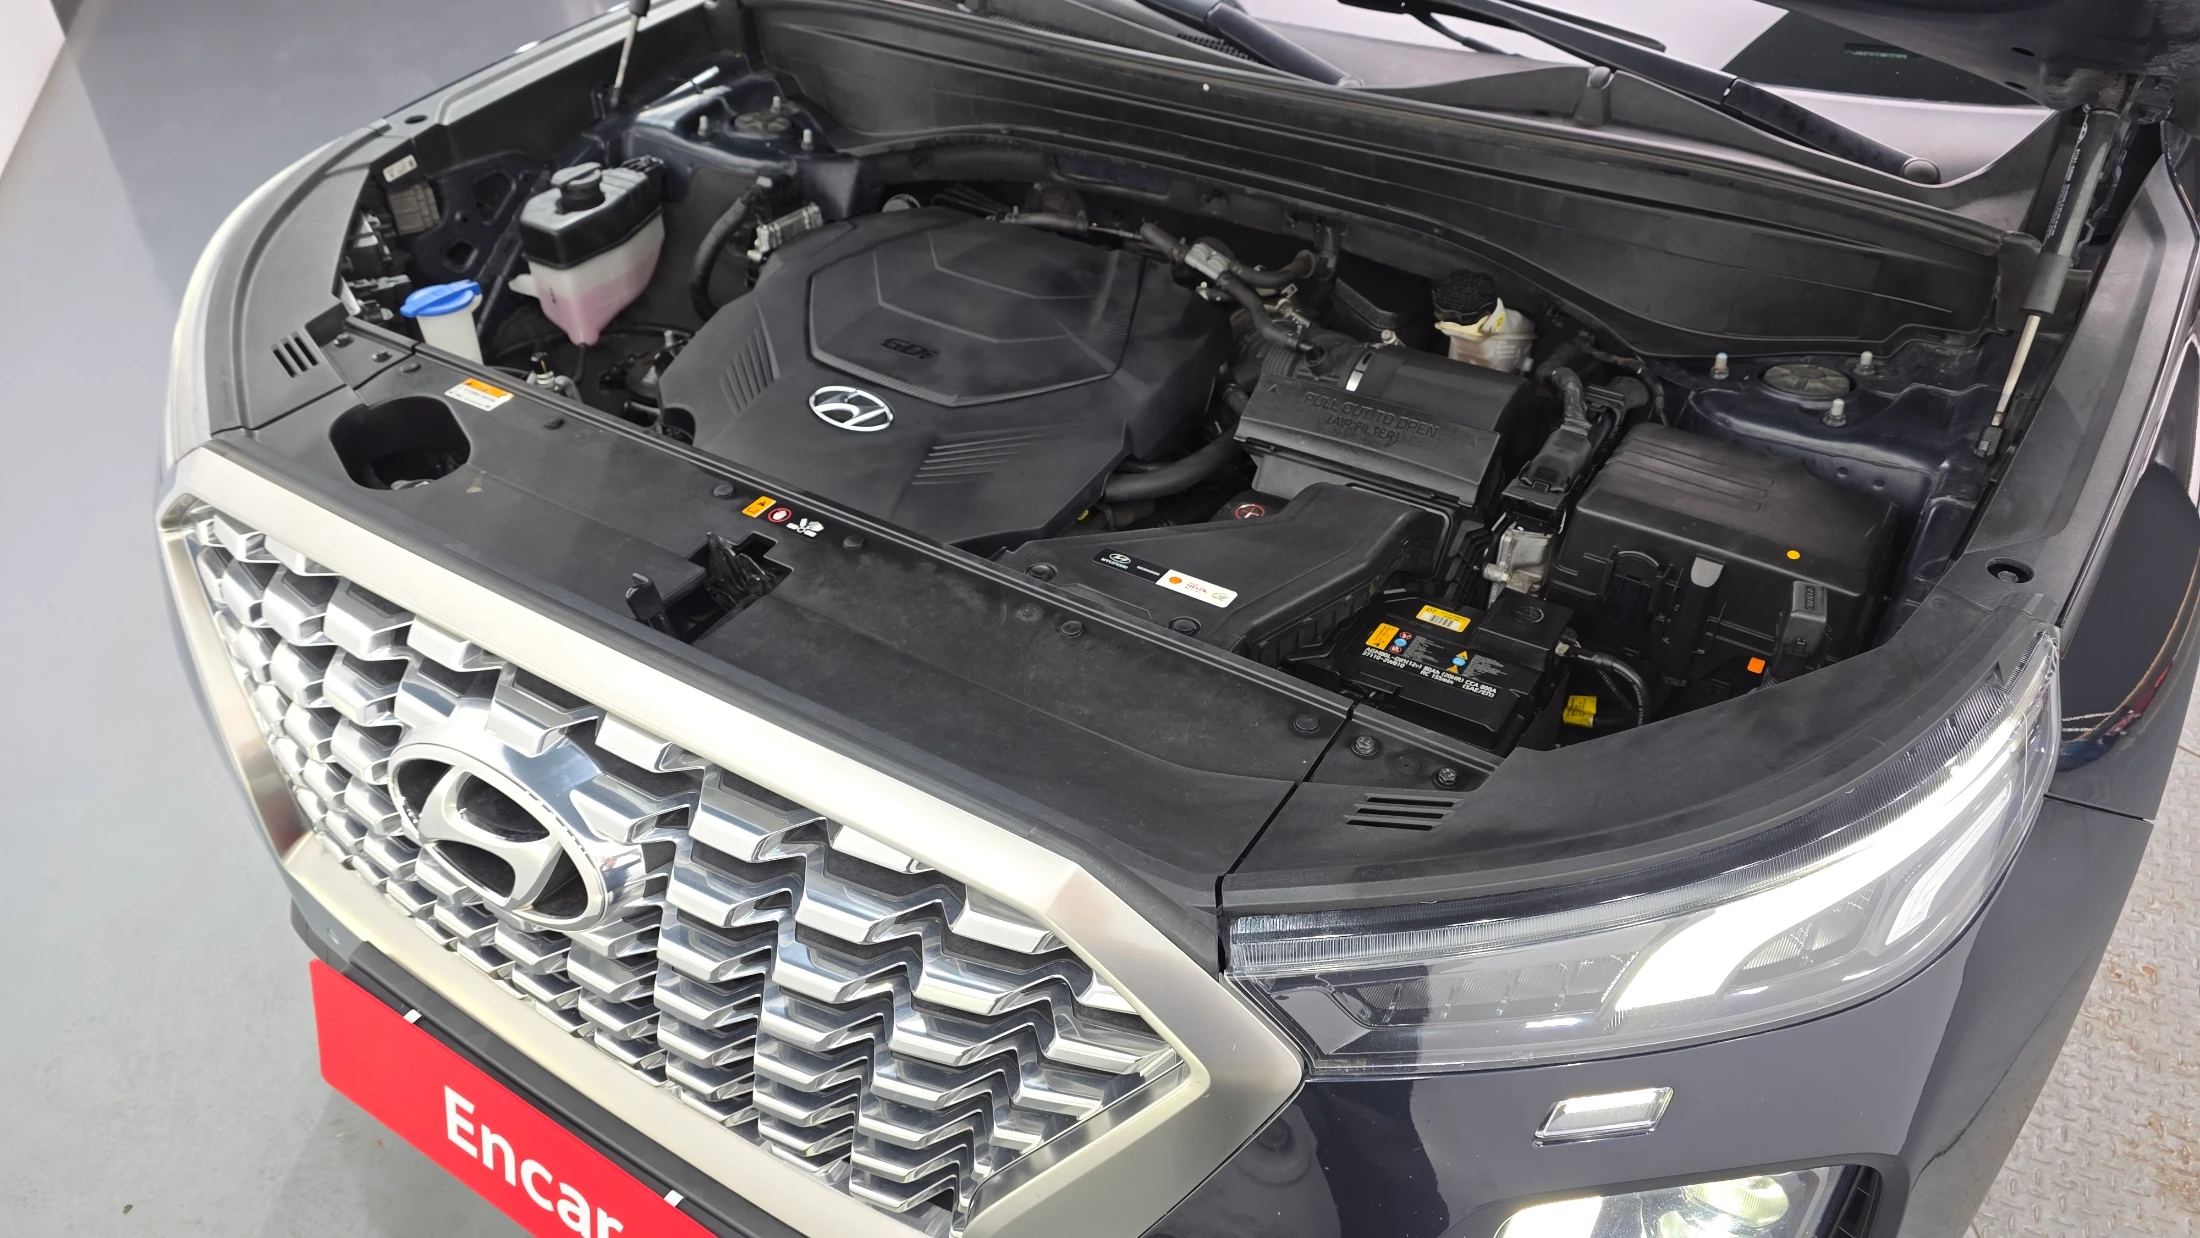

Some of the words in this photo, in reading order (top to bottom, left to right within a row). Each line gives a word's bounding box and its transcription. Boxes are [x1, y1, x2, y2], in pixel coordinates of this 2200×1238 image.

[1302, 391, 1341, 412] PULL
[1341, 400, 1377, 422] OUT
[1375, 409, 1396, 427] TO
[1397, 415, 1440, 439] OPEN
[443, 1085, 625, 1238] Encar
